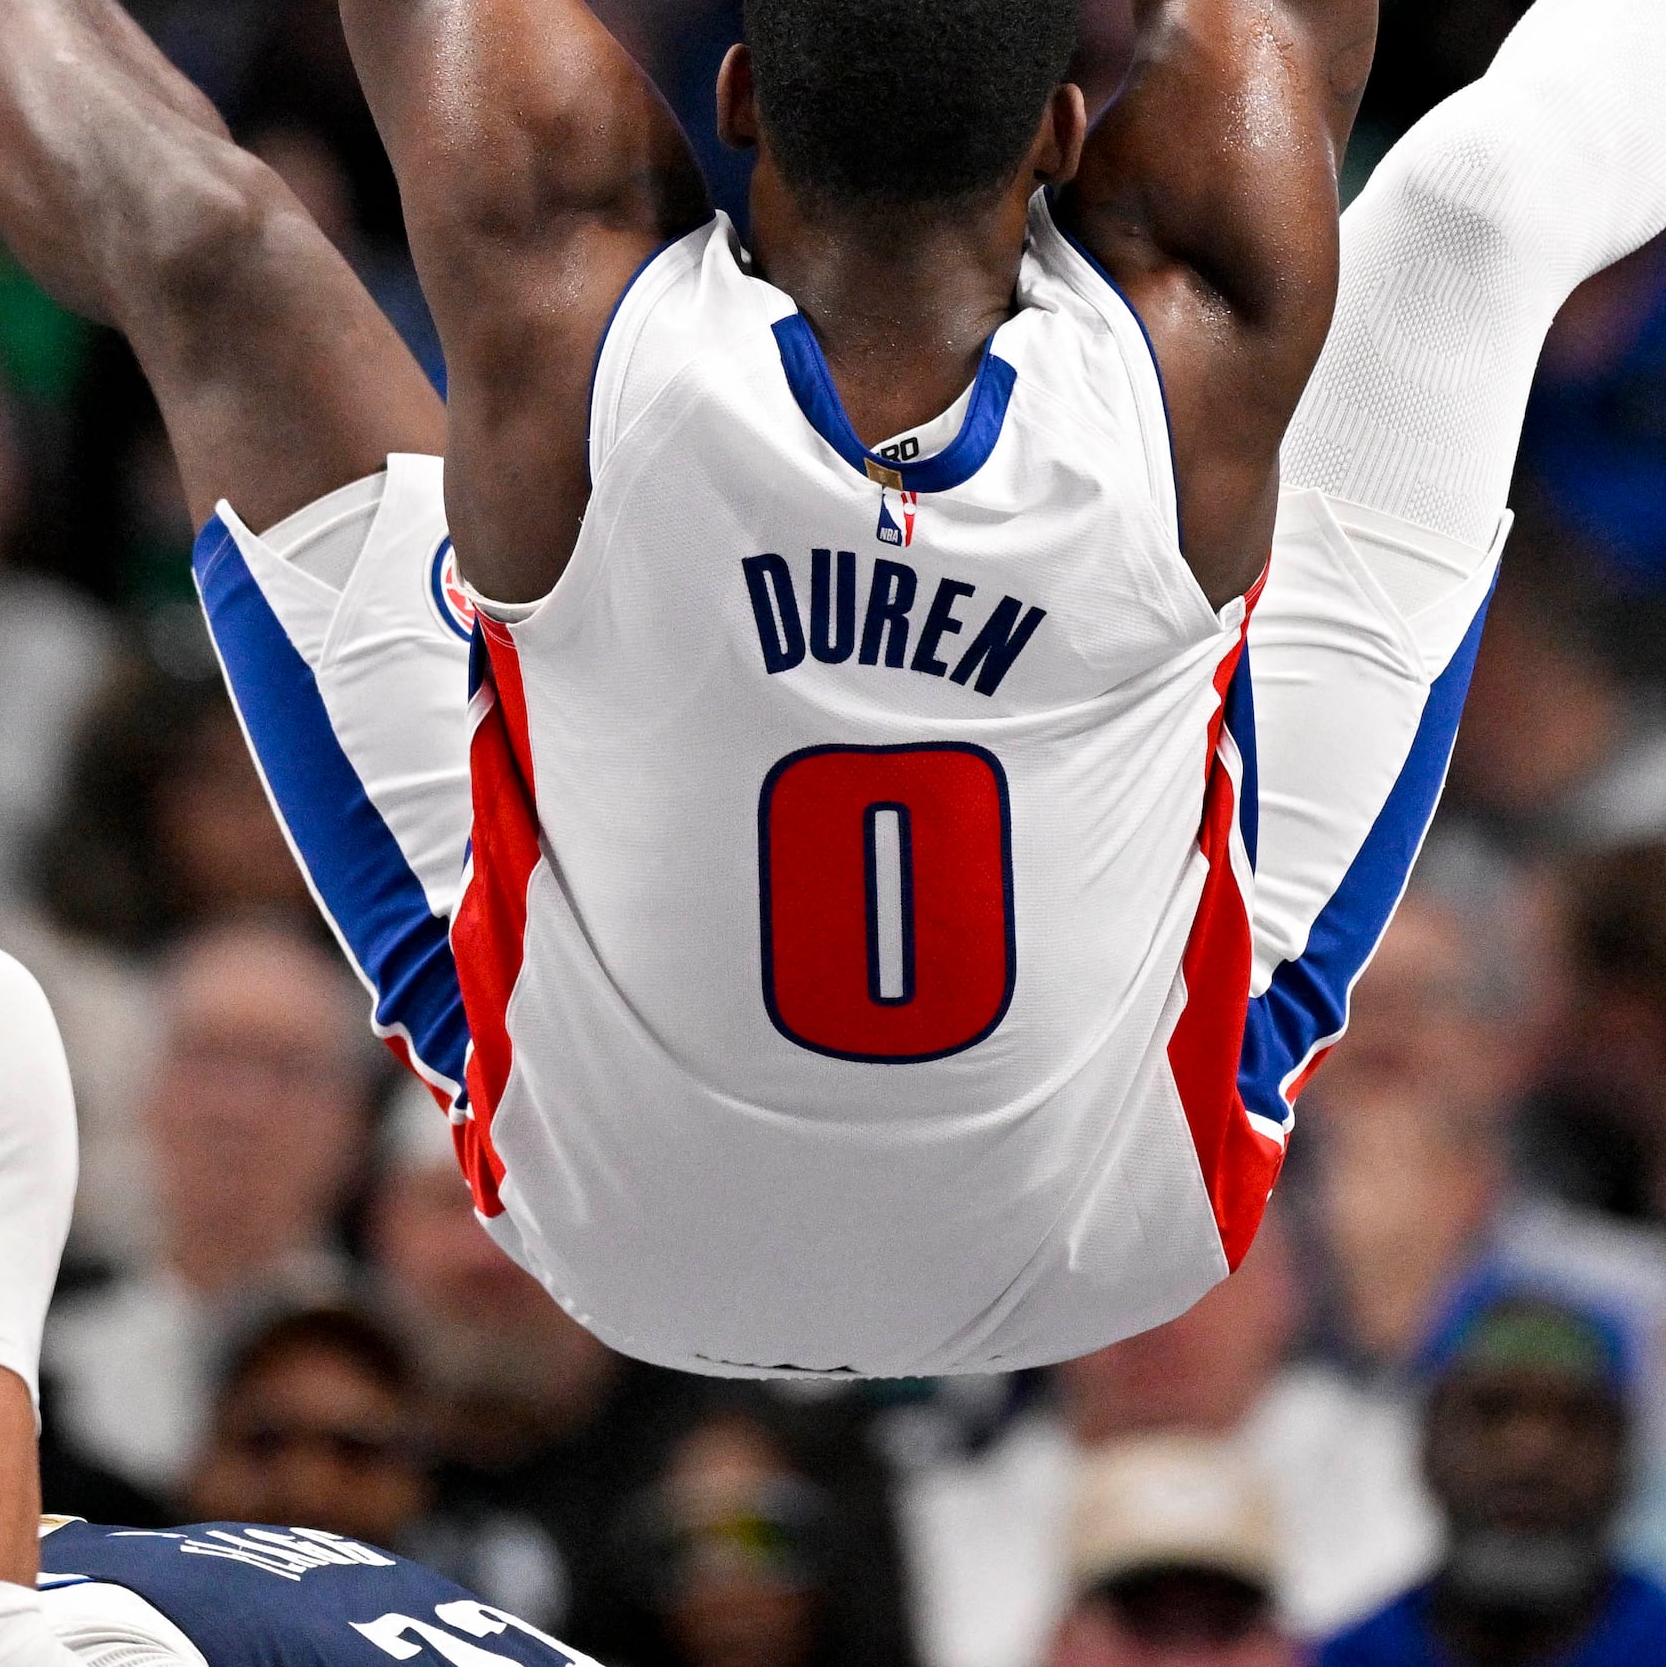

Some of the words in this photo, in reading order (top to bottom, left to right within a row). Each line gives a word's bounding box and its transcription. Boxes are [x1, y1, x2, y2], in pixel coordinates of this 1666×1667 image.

[879, 527, 899, 543] NBA
[742, 548, 1048, 698] DUREN
[757, 741, 1017, 1065] 0
